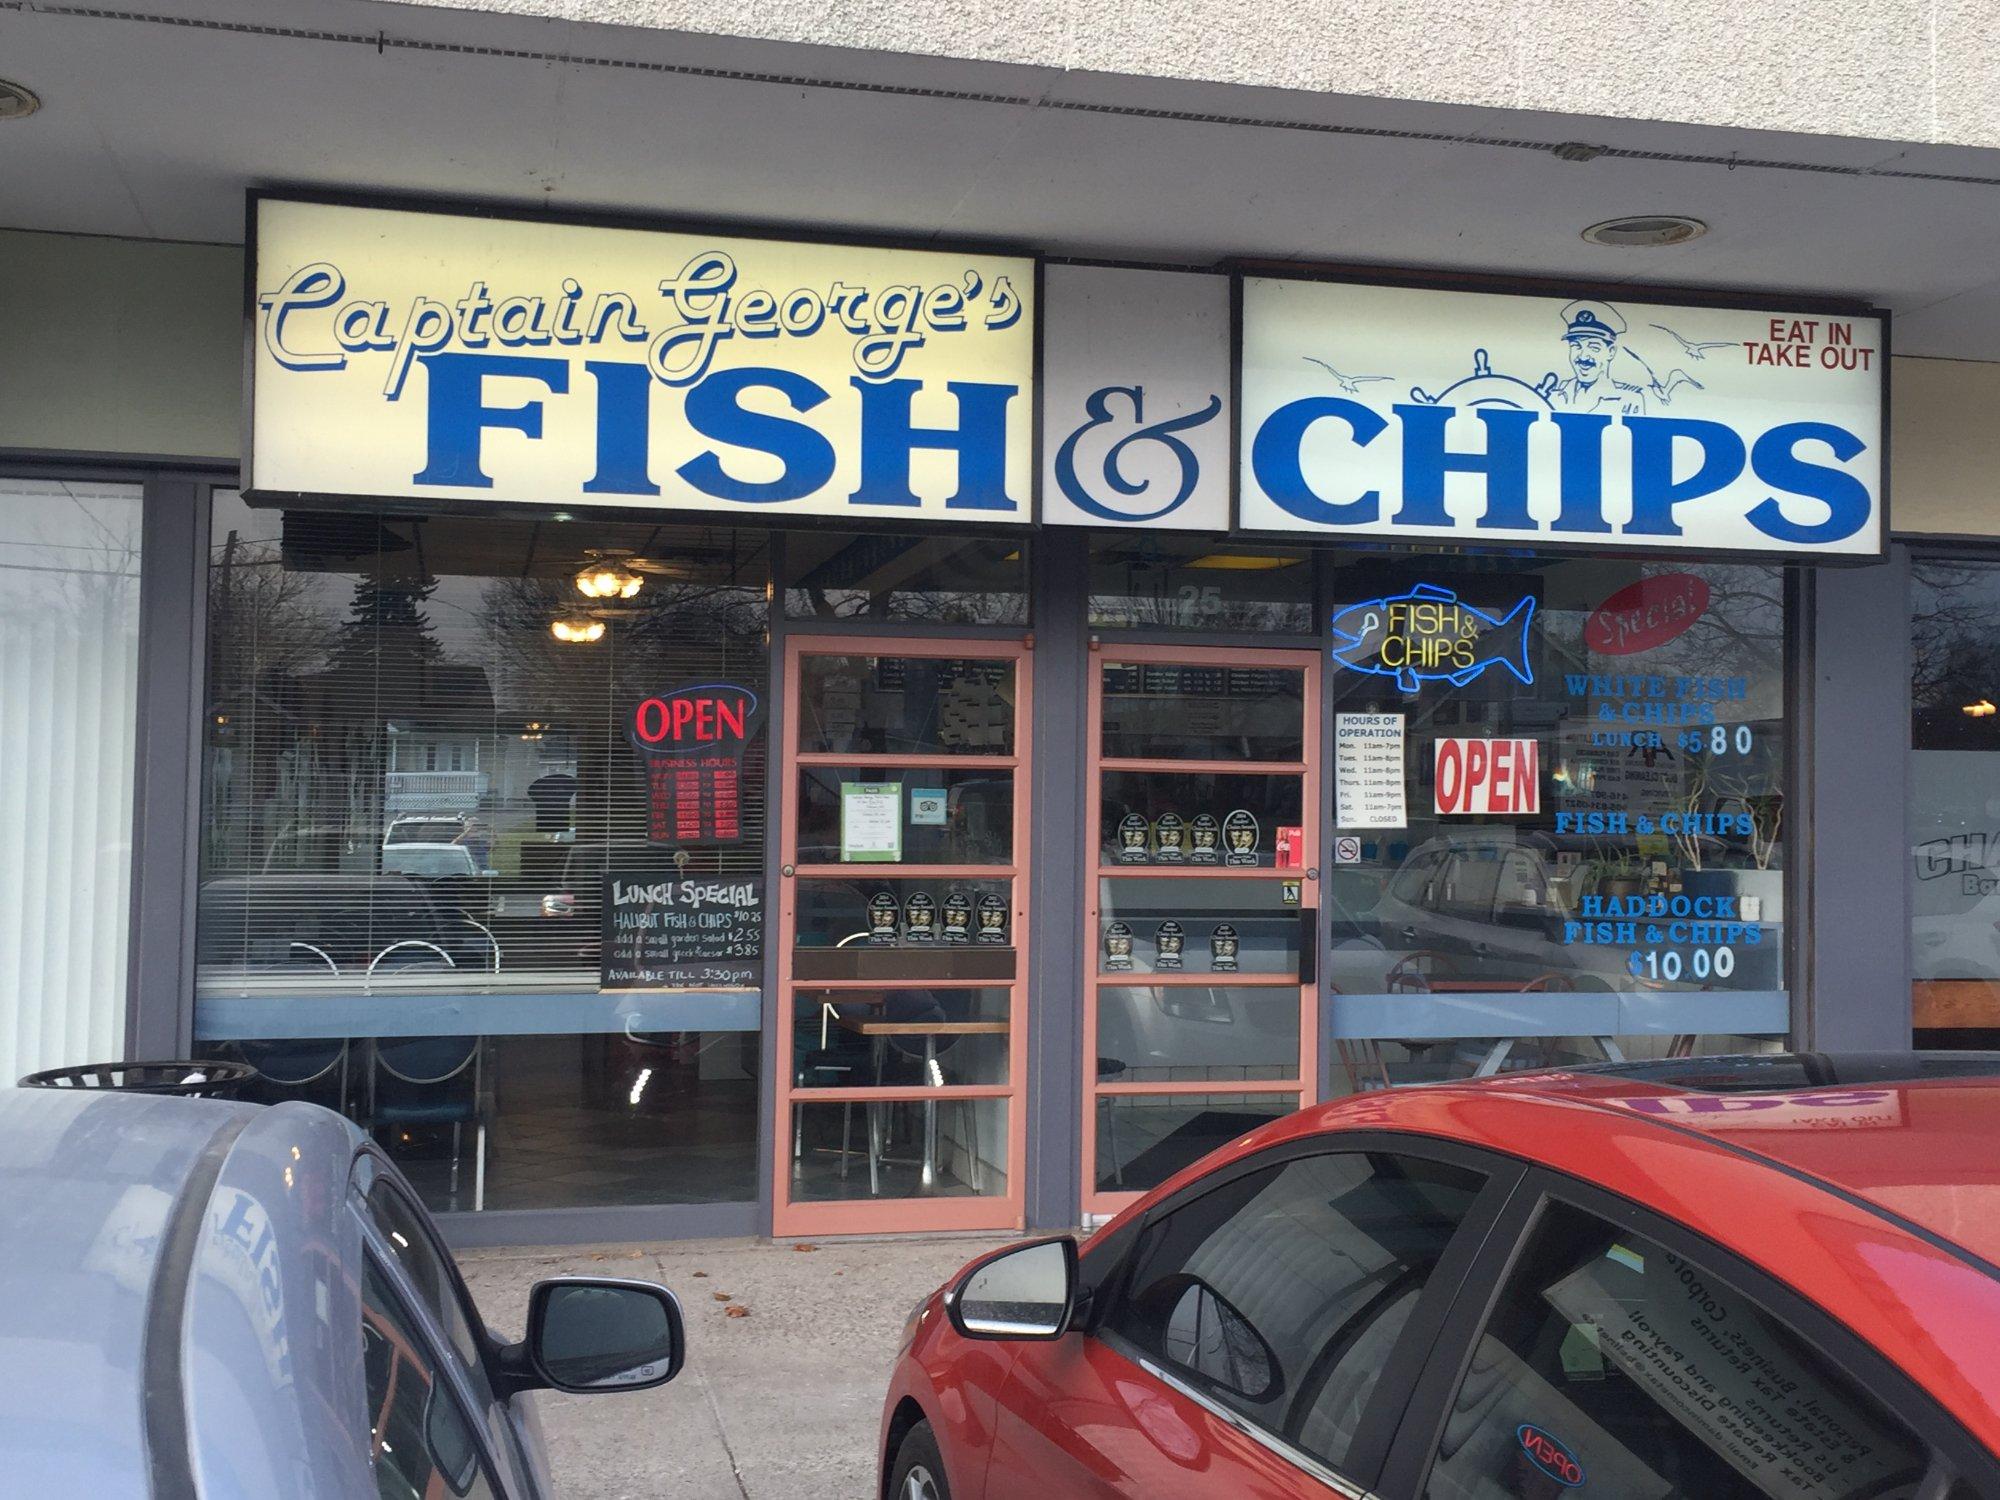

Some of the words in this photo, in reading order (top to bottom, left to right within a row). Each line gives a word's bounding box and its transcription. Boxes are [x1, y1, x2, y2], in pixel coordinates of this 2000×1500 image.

[259, 261, 648, 402] Captain
[647, 250, 1023, 383] George's
[1770, 319, 1819, 343] EAT
[1828, 323, 1852, 345] IN
[1743, 342, 1810, 367] TAKE
[1821, 346, 1875, 371] OUT
[413, 352, 1020, 513] FISH
[1054, 385, 1222, 523] &
[1251, 395, 1872, 545] CHIPS
[1389, 603, 1459, 634] FISH
[1460, 615, 1479, 640] &
[1381, 635, 1475, 669] CHIPS
[1564, 674, 1665, 697] WHITE
[1675, 676, 1748, 700] FISH
[635, 698, 745, 743] OPEN
[1342, 716, 1380, 726] HOURS
[1383, 716, 1398, 726] OF
[1599, 702, 1617, 722] &
[1621, 702, 1717, 725] CHIPS
[1338, 728, 1402, 738] OPERATION
[1592, 730, 1663, 748] LUNCH
[1436, 738, 1539, 815] OPEN
[1369, 815, 1398, 823] CLOSED
[1554, 811, 1628, 835] FISH
[1636, 815, 1655, 836] &
[1660, 812, 1754, 836] CHIPS
[612, 880, 675, 906] LUNCH
[678, 880, 760, 909] SPECIAL
[1582, 895, 1736, 918] HADDOCK
[613, 912, 660, 930] HALIBUT
[664, 912, 687, 929] FISH
[697, 913, 732, 929] CHIPS
[1563, 921, 1638, 944] FISH
[1645, 924, 1664, 944] &
[1669, 921, 1763, 944] CHIPS
[608, 968, 665, 982] AVAILABLE
[668, 970, 695, 980] TILL
